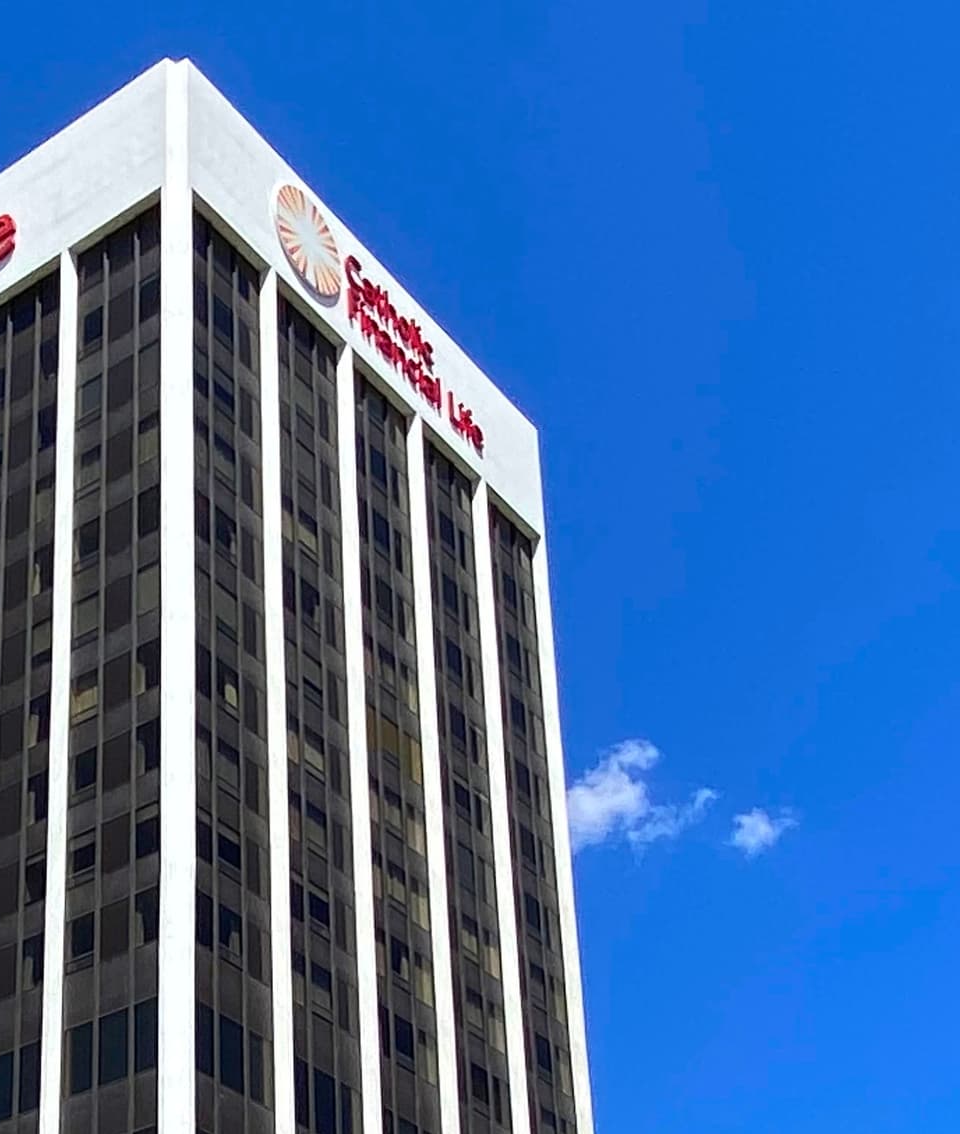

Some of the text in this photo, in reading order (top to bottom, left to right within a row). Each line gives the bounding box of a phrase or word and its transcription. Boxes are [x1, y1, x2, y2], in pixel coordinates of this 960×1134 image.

[345, 255, 434, 373] Catholic
[347, 287, 485, 451] Financial Life
